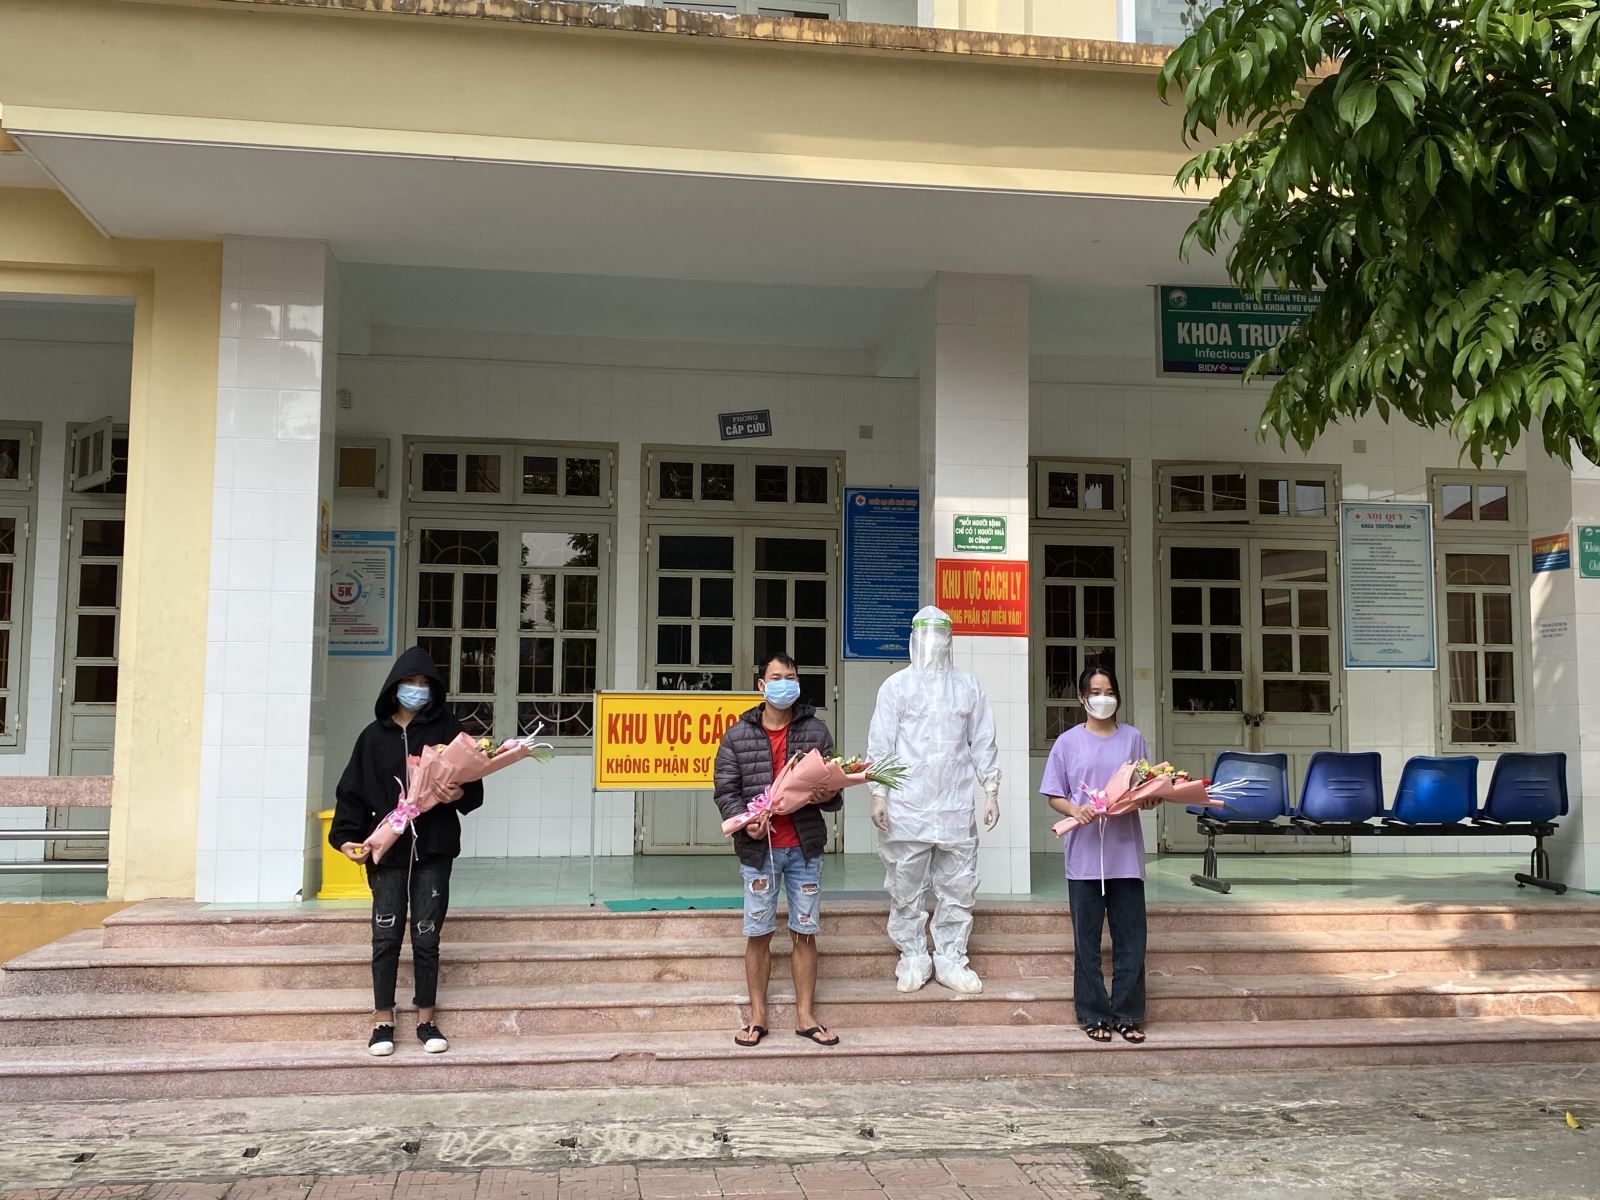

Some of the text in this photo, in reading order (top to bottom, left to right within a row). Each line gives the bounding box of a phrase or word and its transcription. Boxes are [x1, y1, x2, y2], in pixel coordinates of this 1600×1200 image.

[1265, 303, 1285, 312] KHOA
[1286, 304, 1302, 312] KHU
[1177, 322, 1232, 346] KHOA
[1195, 347, 1251, 360] Infectious
[1198, 363, 1219, 372] BIDV
[725, 420, 766, 436] CẤP CỨU
[338, 586, 353, 597] 5K
[942, 565, 1022, 606] KHU VỰC CÁCH LY
[963, 606, 981, 628] PHẬN
[981, 608, 991, 628] SỰ
[1007, 608, 1022, 626] VÀO!
[607, 713, 647, 745] KHU
[654, 710, 692, 752] VỰC
[606, 754, 712, 777] KHÔNG PHẬN SỰ
